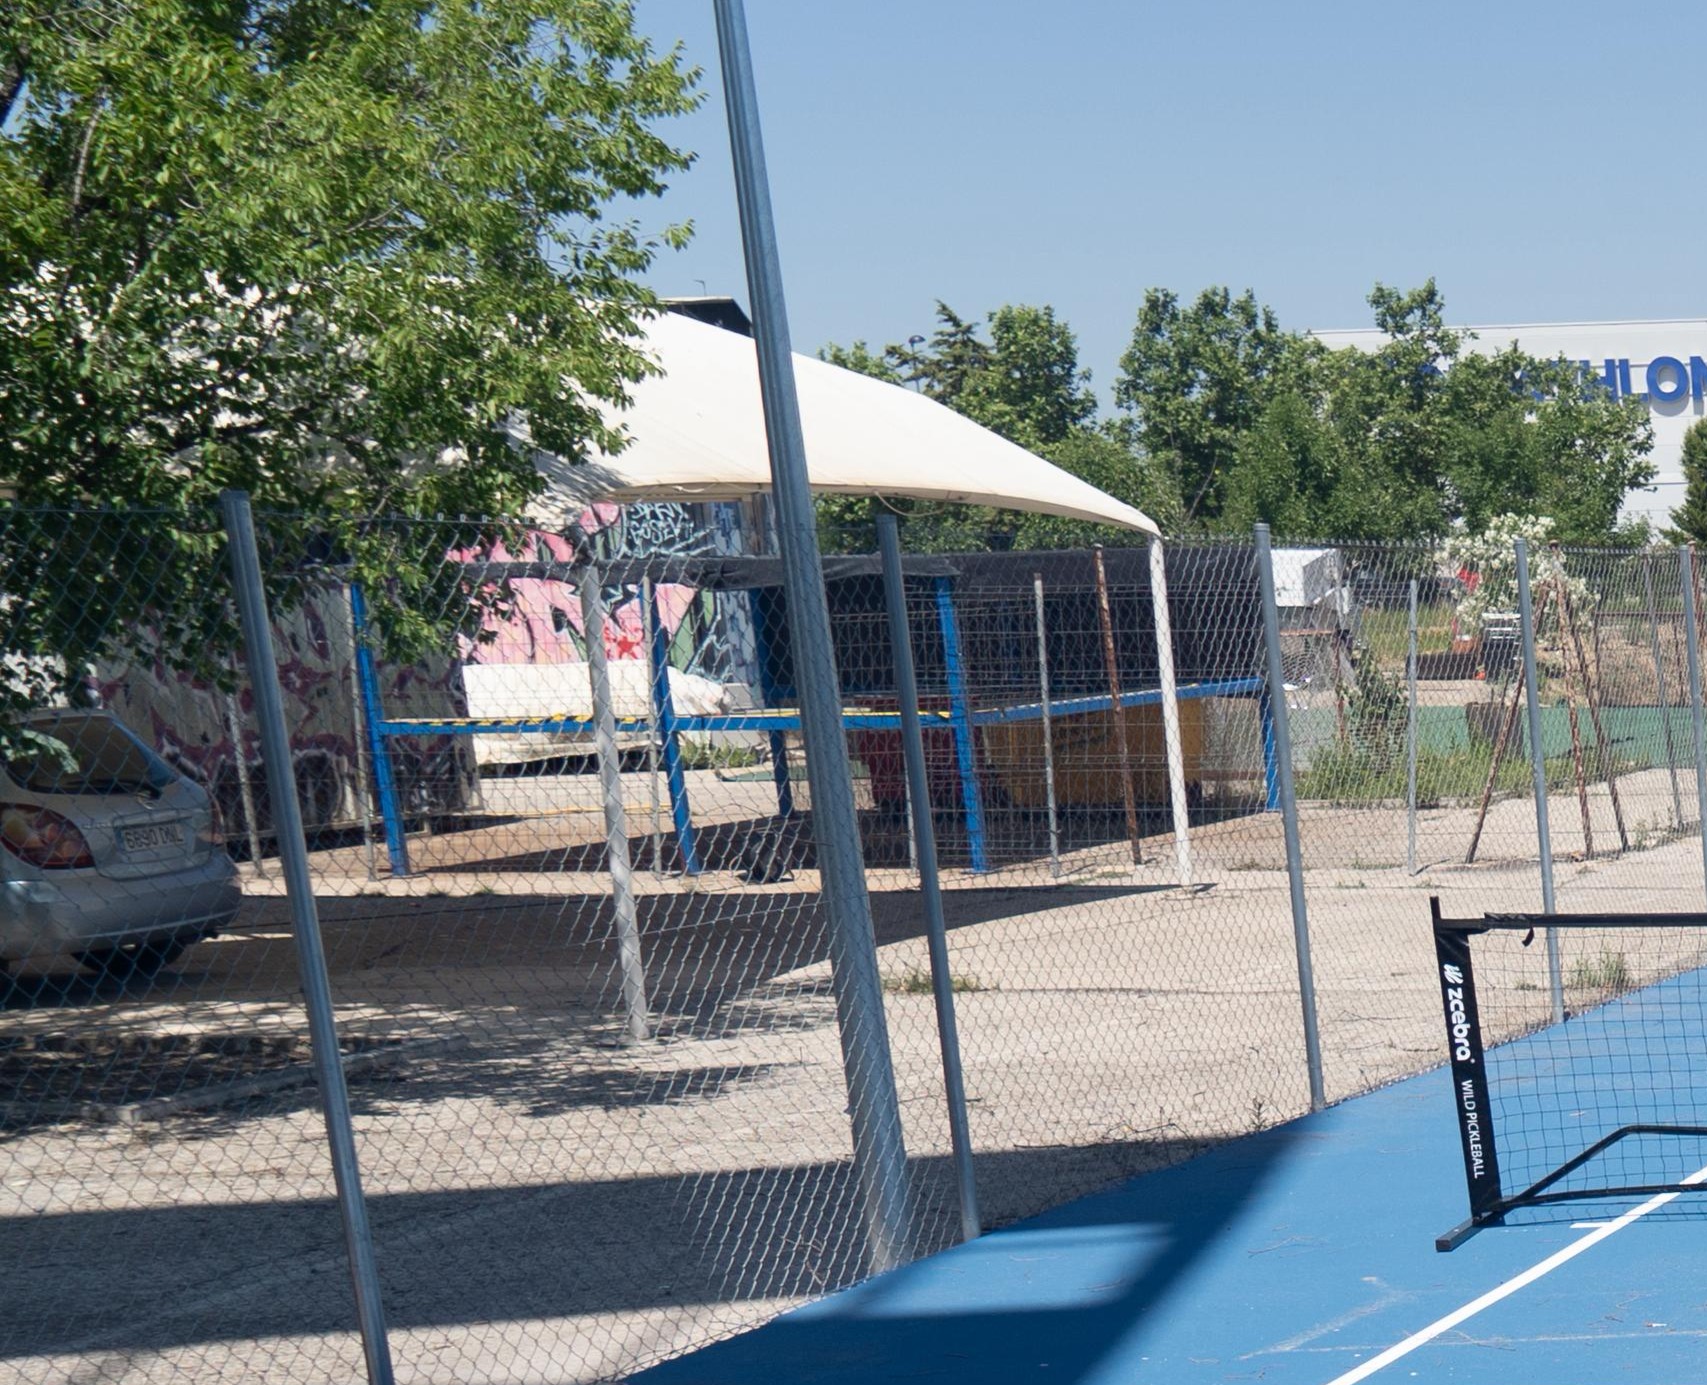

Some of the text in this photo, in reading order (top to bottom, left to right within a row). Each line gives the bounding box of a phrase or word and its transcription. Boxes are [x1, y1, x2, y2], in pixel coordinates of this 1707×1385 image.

[1447, 987, 1472, 1063] zcebra
[1461, 1079, 1485, 1179] WILD PICKLEBALL
